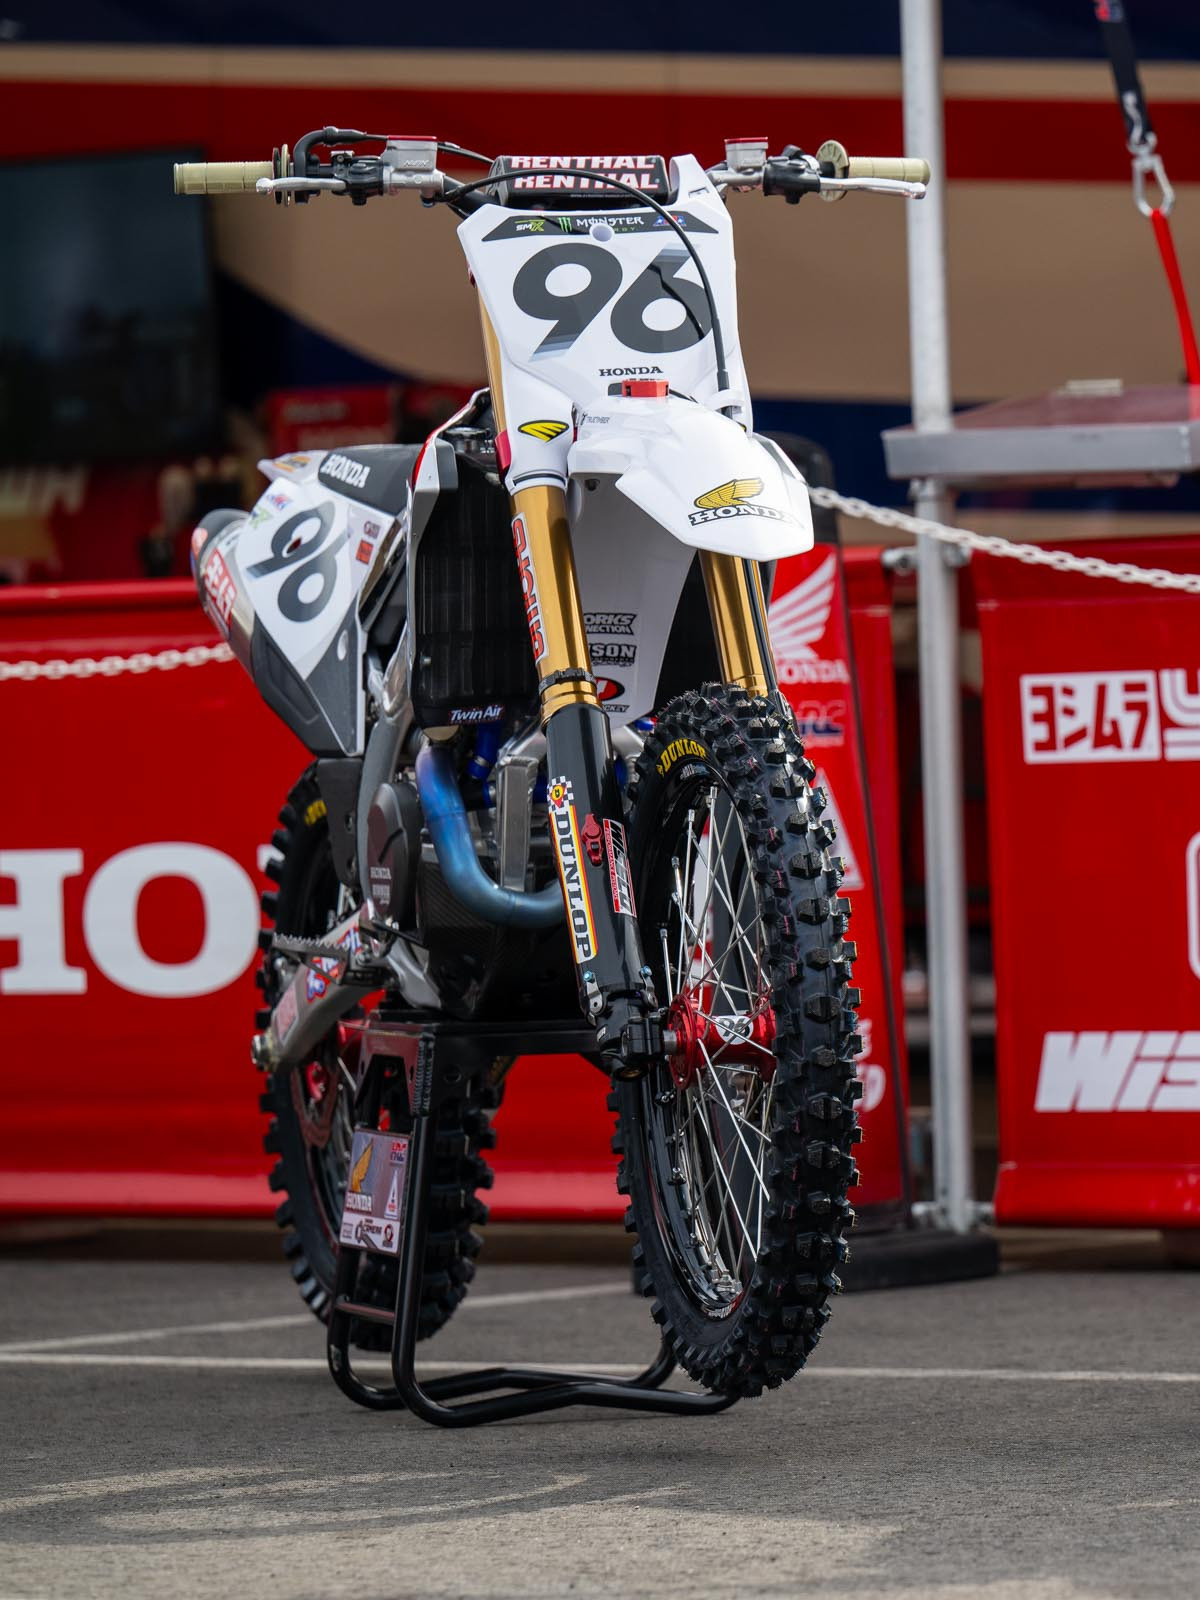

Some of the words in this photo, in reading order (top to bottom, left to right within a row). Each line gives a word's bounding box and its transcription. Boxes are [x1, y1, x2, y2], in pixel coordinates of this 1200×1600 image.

[511, 156, 655, 169] RENTHAL
[514, 173, 659, 189] RENTHAL
[576, 216, 645, 228] MONSTER
[512, 242, 714, 362] 96
[598, 366, 664, 377] HONDA
[320, 454, 371, 488] HONDA
[689, 503, 806, 526] HONDA
[246, 500, 349, 623] 96
[583, 614, 635, 625] ORKS
[778, 659, 850, 684] ONDA
[603, 705, 628, 713] CKEY
[555, 811, 592, 958] DUNLOP
[0, 840, 285, 998] HO
